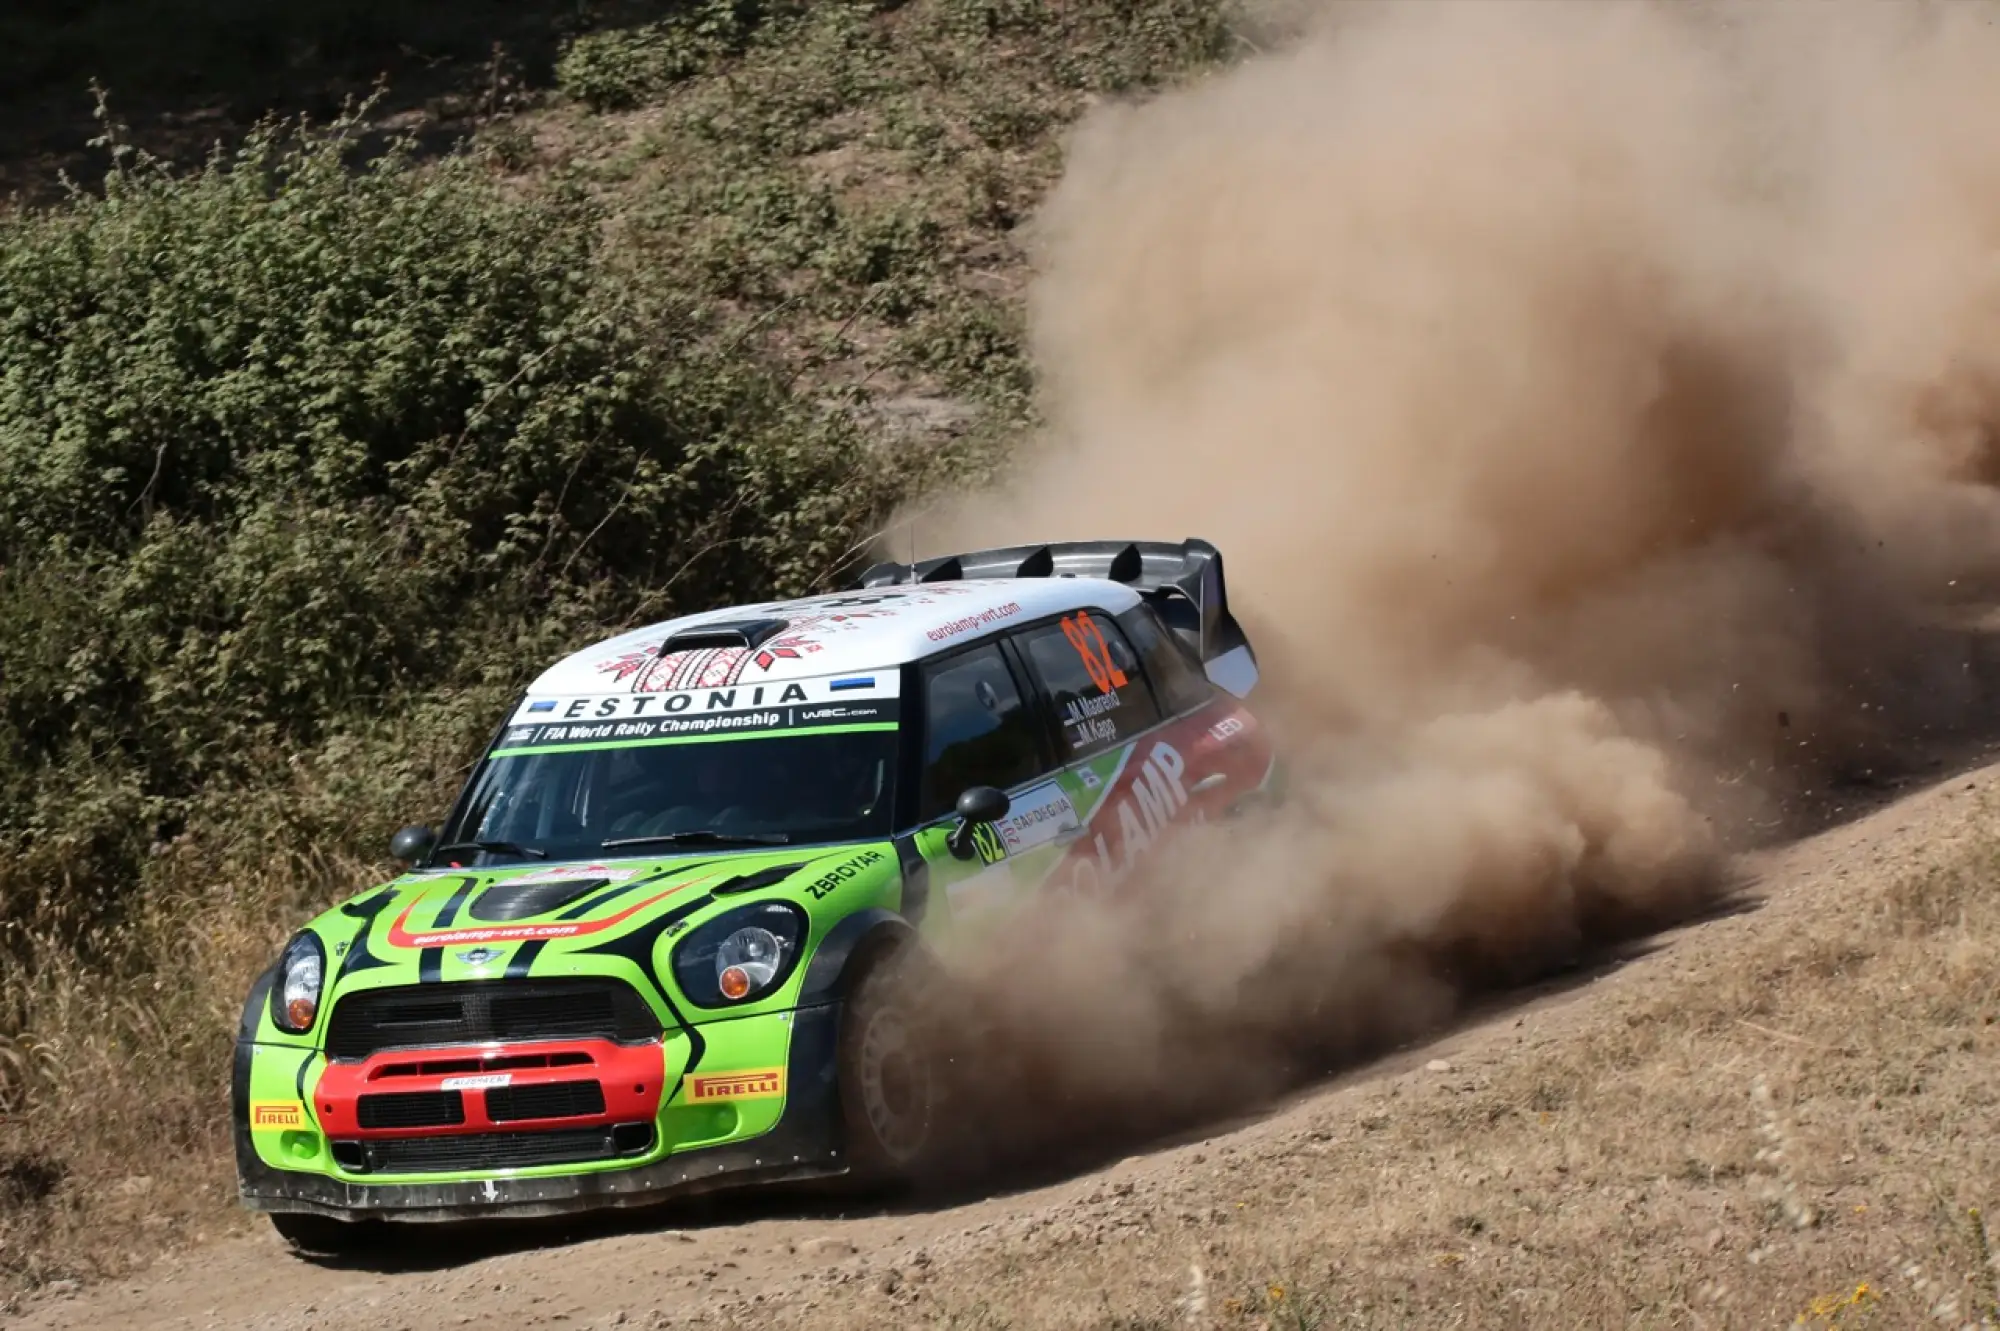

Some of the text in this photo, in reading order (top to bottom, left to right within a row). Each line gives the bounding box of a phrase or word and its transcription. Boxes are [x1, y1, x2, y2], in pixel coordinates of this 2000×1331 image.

[925, 600, 1023, 642] eurolamp-wrt.com
[1060, 609, 1129, 694] 82
[563, 682, 809, 719] ESTONIA
[543, 726, 566, 741] FIA
[569, 722, 611, 739] World
[613, 718, 657, 737] Rally
[659, 711, 781, 733] Championship
[1087, 717, 1117, 742] Kapp
[1208, 717, 1245, 742] LED
[804, 849, 886, 901] ZBROYAR
[413, 924, 579, 946] eurolamp-wrt.com
[693, 1072, 779, 1099] PIRELLI
[254, 1105, 299, 1125] PIRELLI
